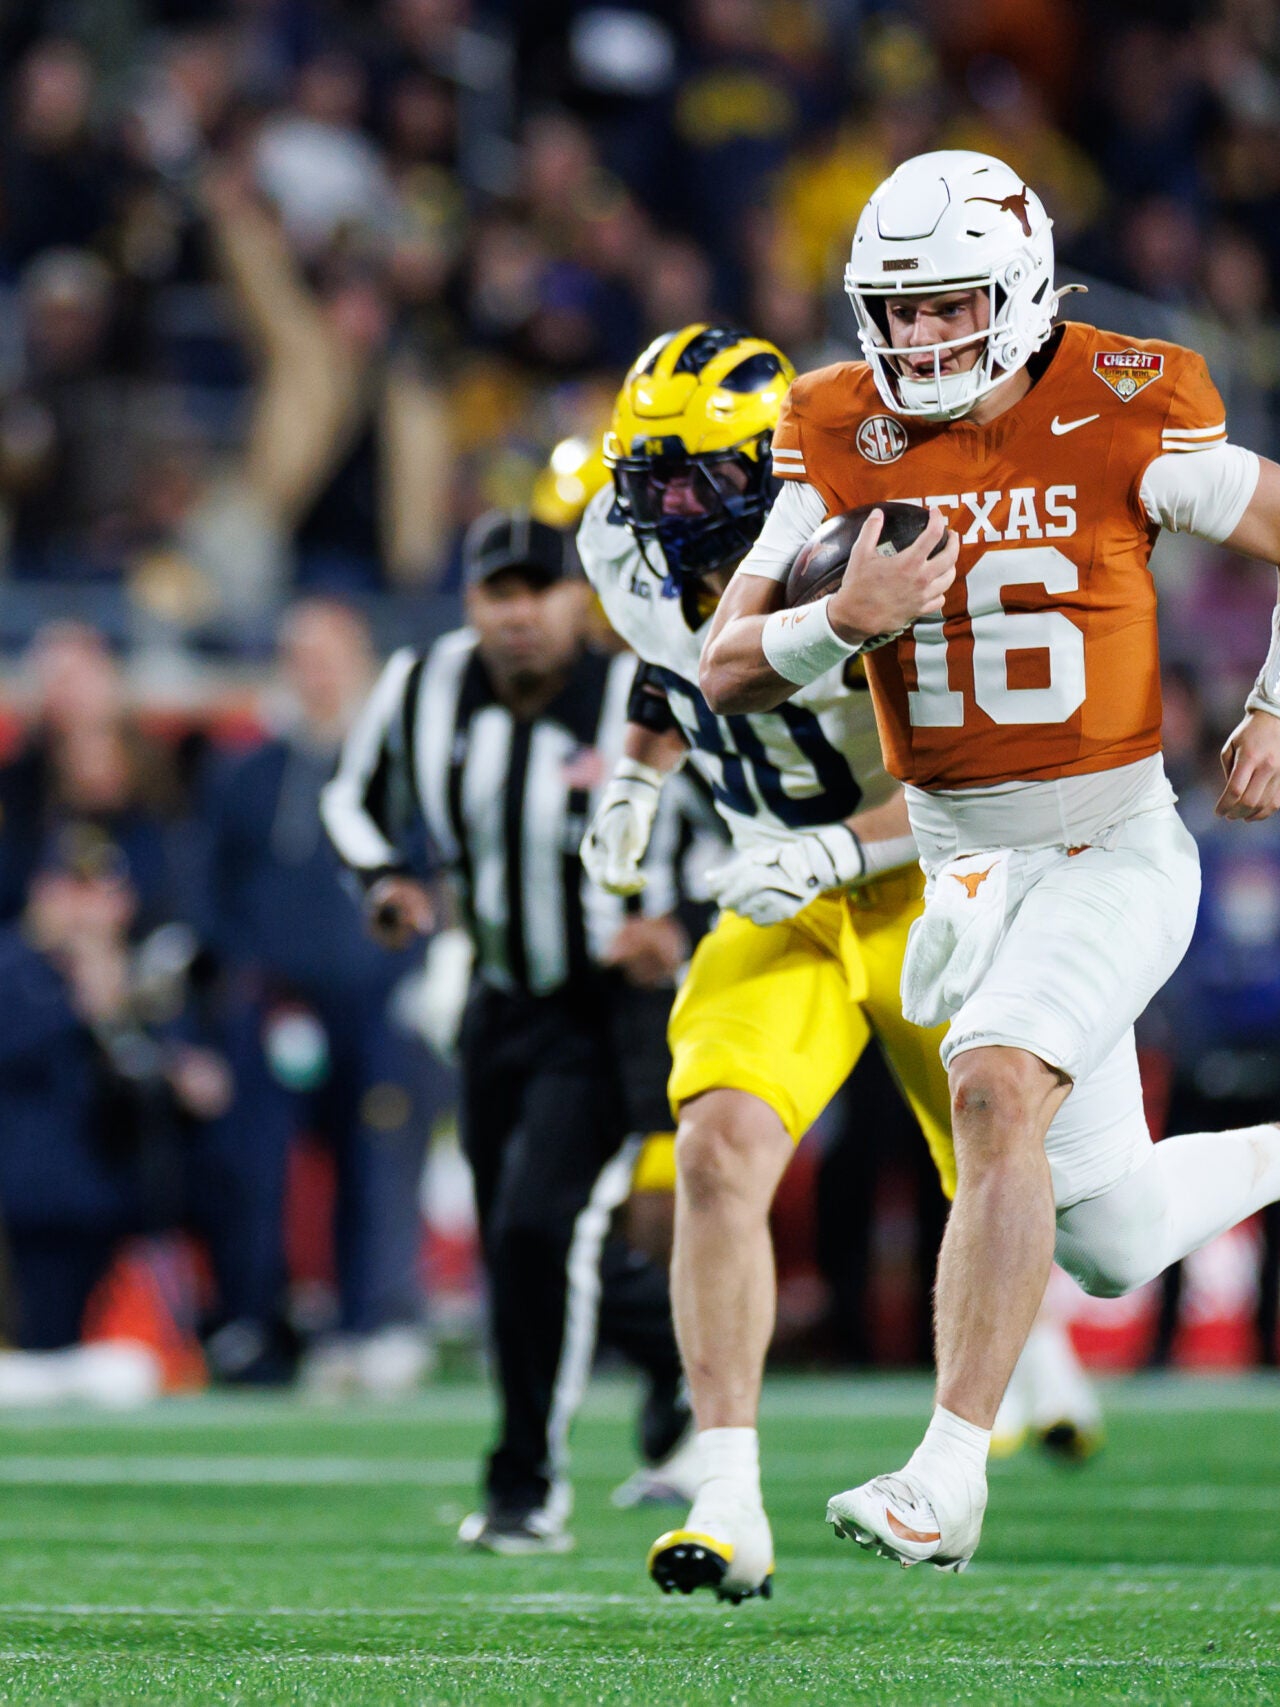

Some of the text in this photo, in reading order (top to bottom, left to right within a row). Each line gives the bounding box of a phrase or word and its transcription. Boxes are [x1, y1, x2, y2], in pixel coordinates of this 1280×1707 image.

[860, 418, 904, 461] SEC
[886, 484, 1078, 544] XAS
[908, 546, 1087, 728] 16
